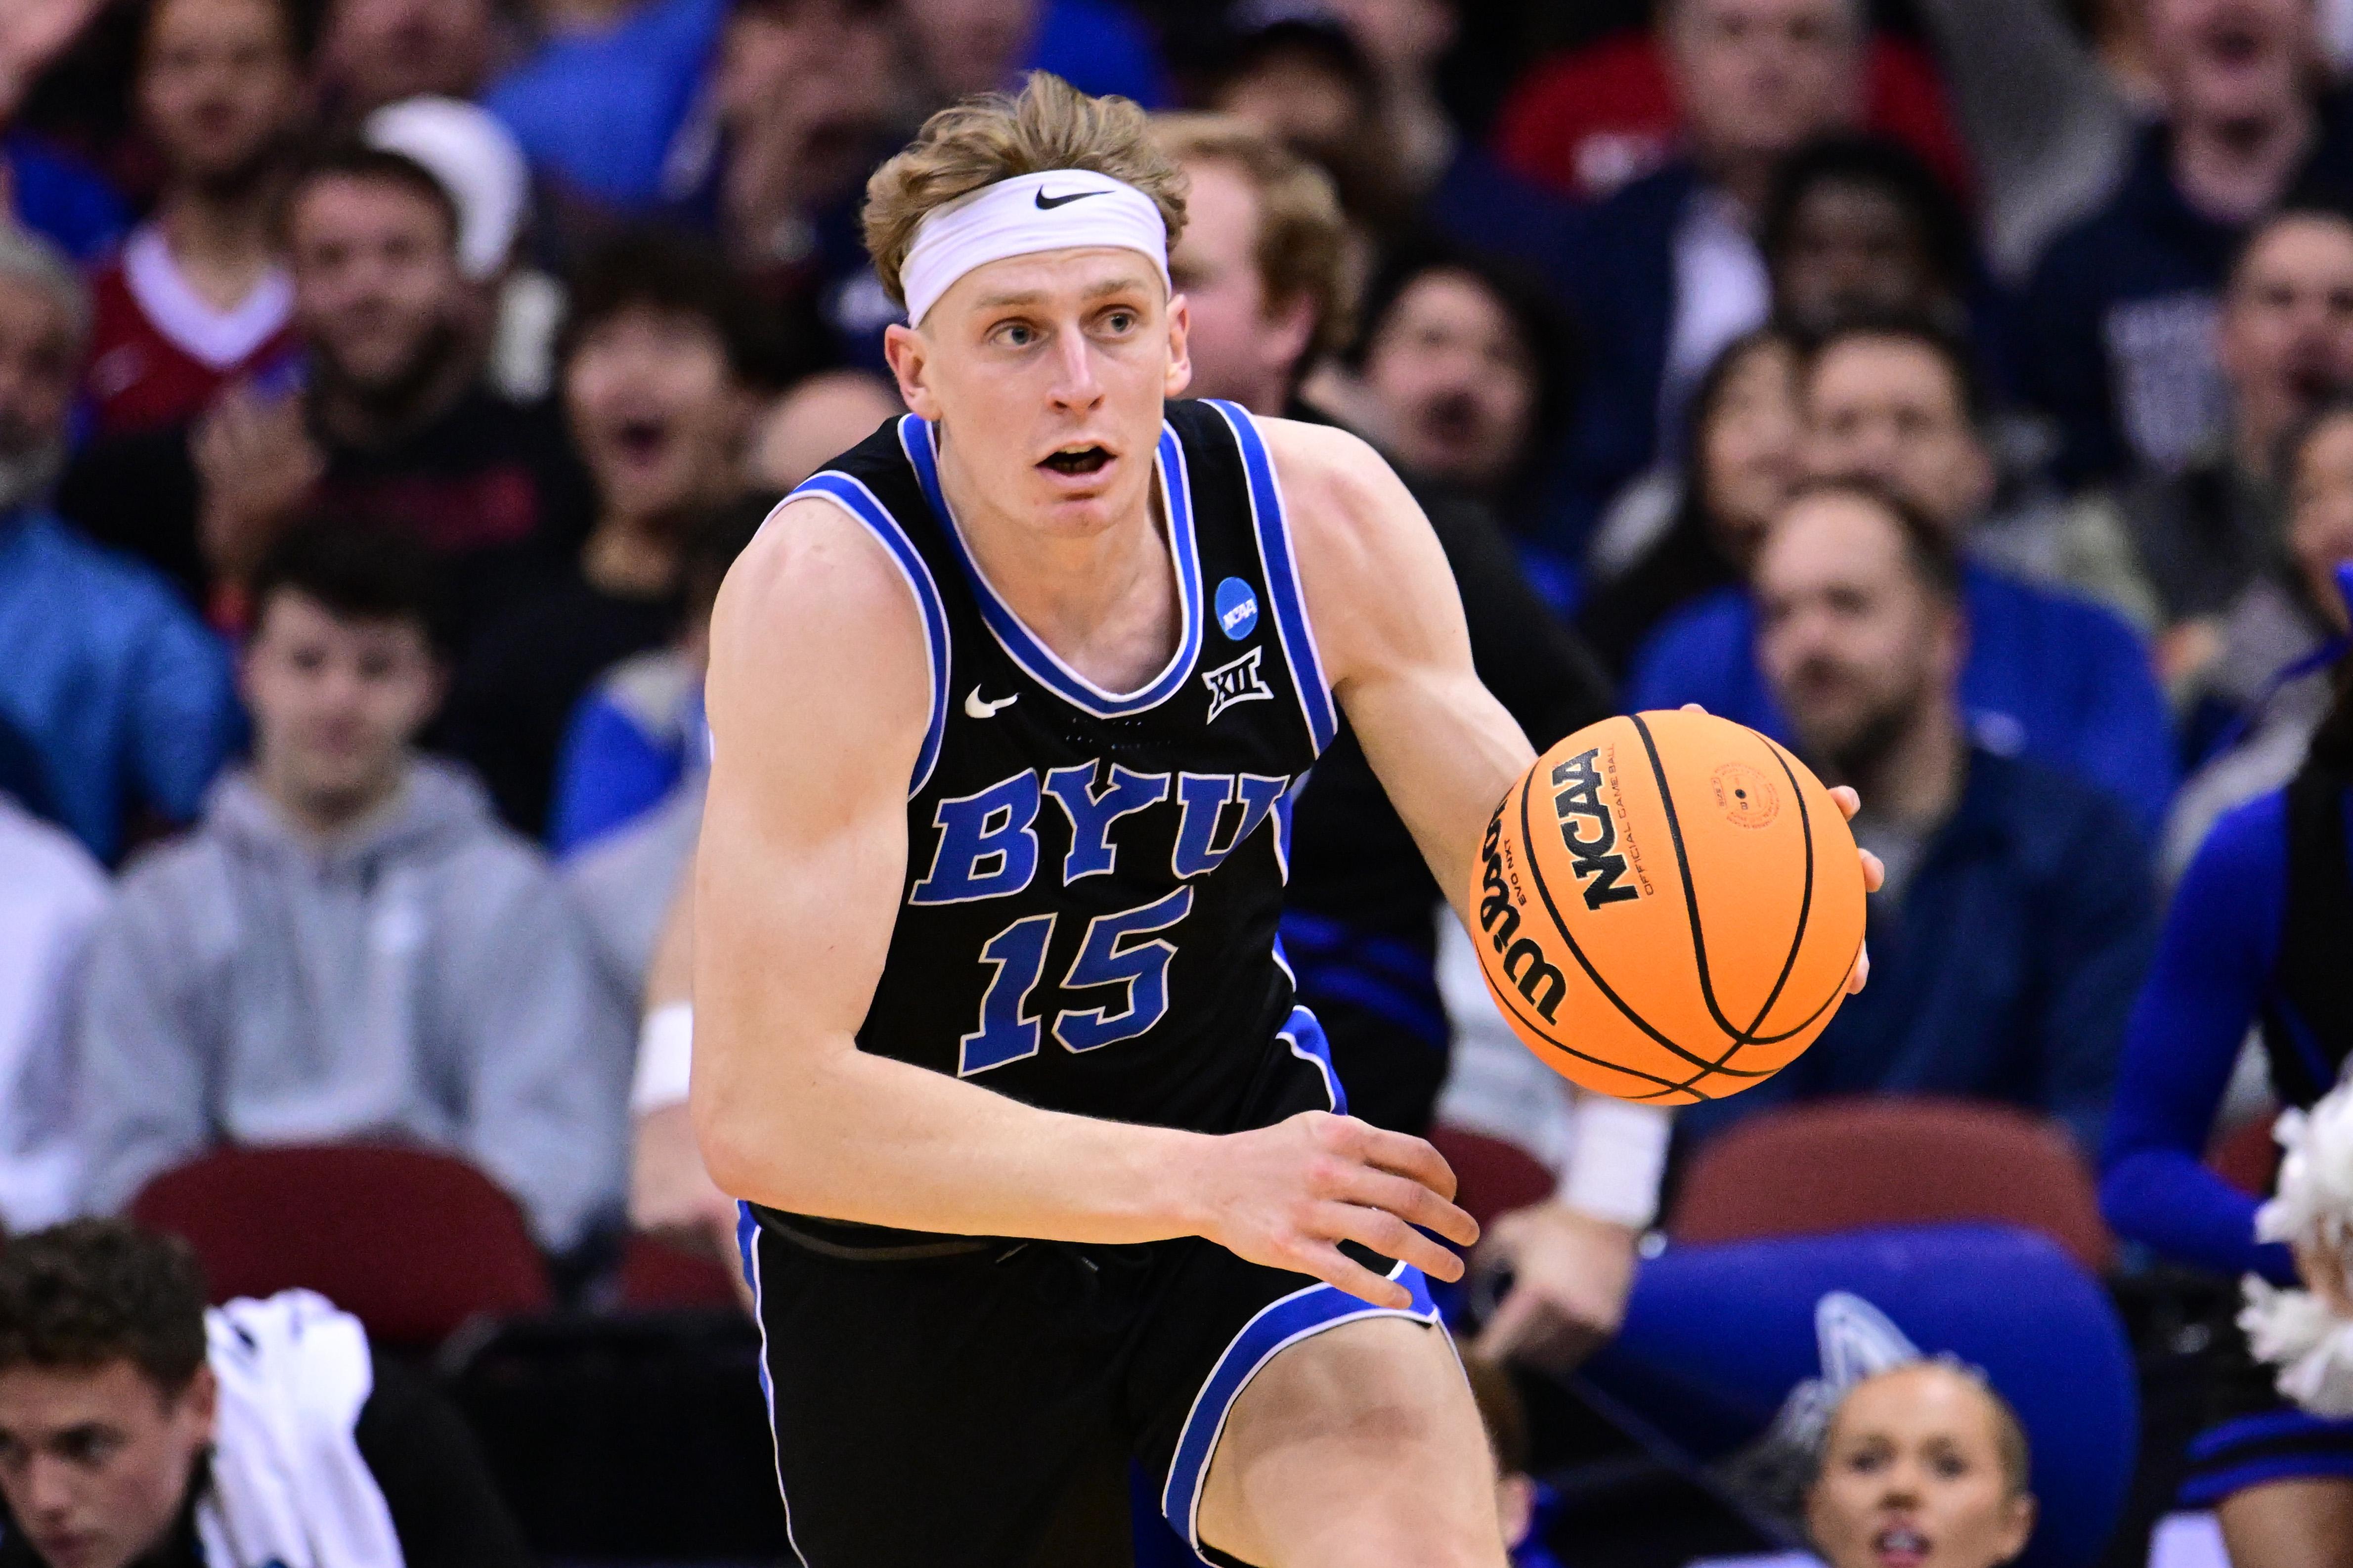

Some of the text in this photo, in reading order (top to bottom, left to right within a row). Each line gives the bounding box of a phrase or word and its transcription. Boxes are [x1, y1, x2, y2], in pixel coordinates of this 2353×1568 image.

[1223, 598, 1258, 631] NCAA
[908, 758, 1291, 905] BYU
[1504, 839, 1526, 907] EVO NXT
[1552, 747, 1640, 911] NCAA
[1623, 821, 1654, 896] OFFICIAL
[958, 884, 1194, 1077] 15
